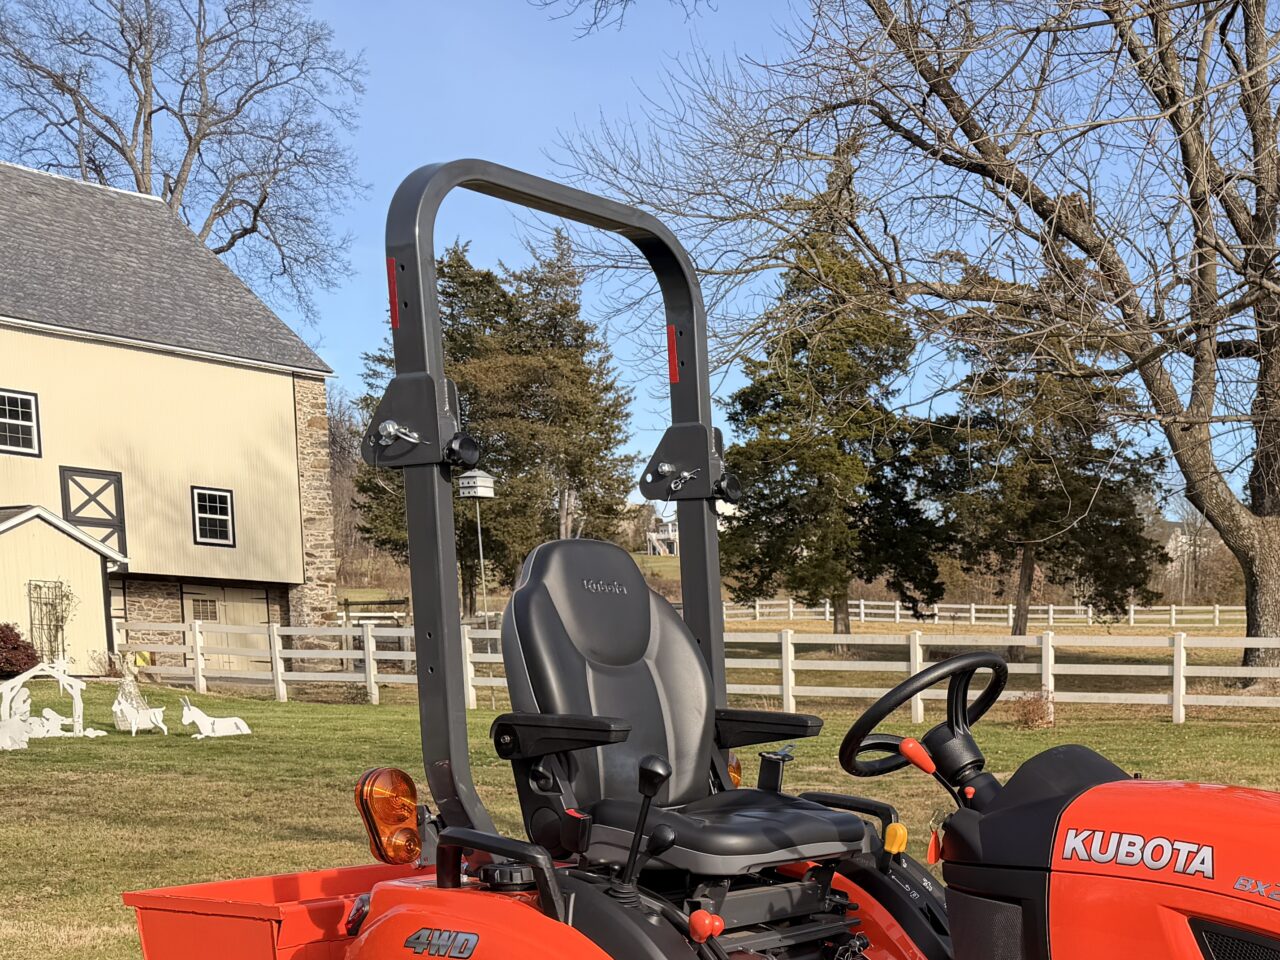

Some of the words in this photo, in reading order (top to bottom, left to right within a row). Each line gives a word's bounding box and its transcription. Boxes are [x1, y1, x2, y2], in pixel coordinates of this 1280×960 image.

[583, 579, 628, 595] Kubota
[1062, 828, 1215, 880] KUBOTA
[404, 927, 480, 960] 4WD
